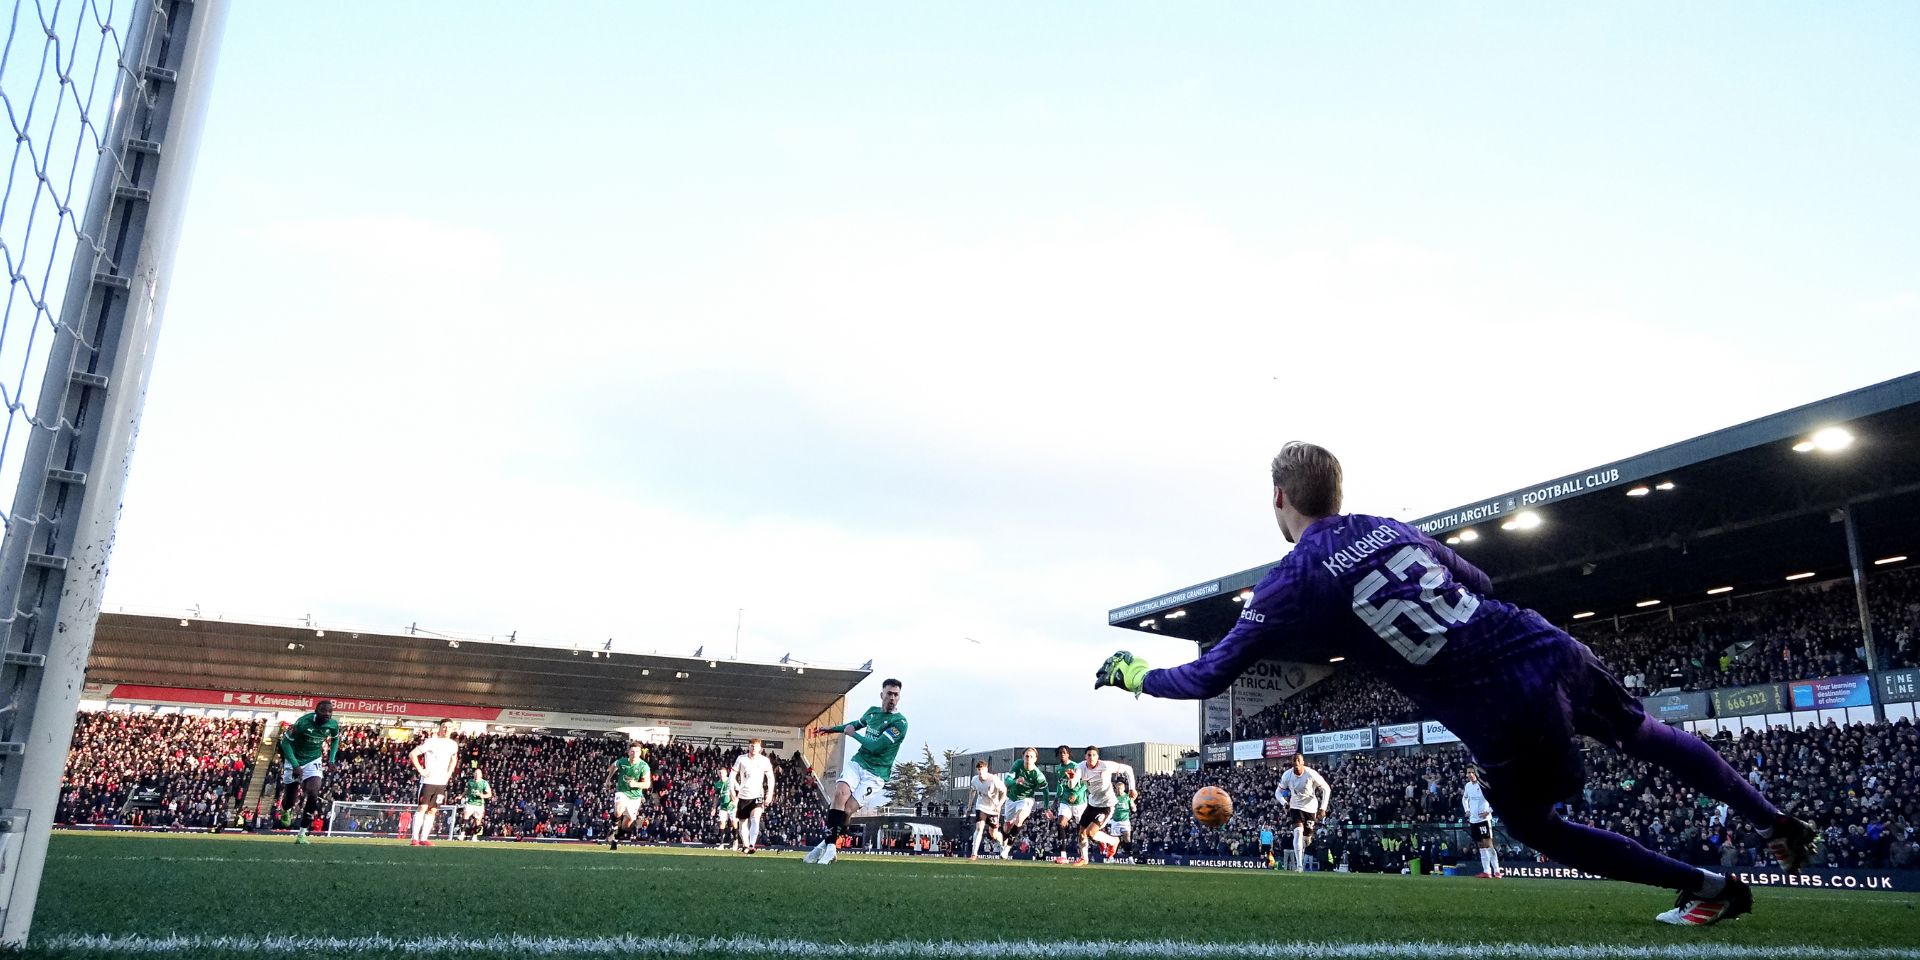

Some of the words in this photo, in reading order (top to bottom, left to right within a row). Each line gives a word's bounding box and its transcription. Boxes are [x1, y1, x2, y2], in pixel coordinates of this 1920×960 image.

[1416, 513, 1458, 533] MOUTH
[1460, 502, 1500, 524] ARGYLE
[1522, 480, 1583, 506] FOOTBALL
[1585, 468, 1620, 488] CLUB
[1119, 609, 1135, 618] BEACON
[1135, 603, 1159, 614] ELECTRICAL
[1160, 593, 1186, 606] MAYFLOWER
[1187, 583, 1219, 599] GRANDSTAND
[1352, 545, 1480, 665] 62
[1241, 609, 1266, 623] edia
[1240, 677, 1282, 691] TRICAL
[1831, 682, 1857, 690] learning
[1817, 689, 1851, 698] destination
[254, 695, 313, 708] Kawasaki
[331, 699, 355, 710] Barn
[358, 701, 383, 712] Park
[386, 703, 407, 713] End
[1727, 692, 1767, 711] 666-222
[1426, 724, 1447, 734] Vosp
[1340, 733, 1359, 741] Parson
[1317, 743, 1334, 751] Funeral
[865, 786, 873, 797] 9
[1189, 859, 1267, 869] MICHAELSPIERS.CO.UK
[1740, 873, 1893, 889] ELSPIERS.CO.UK
